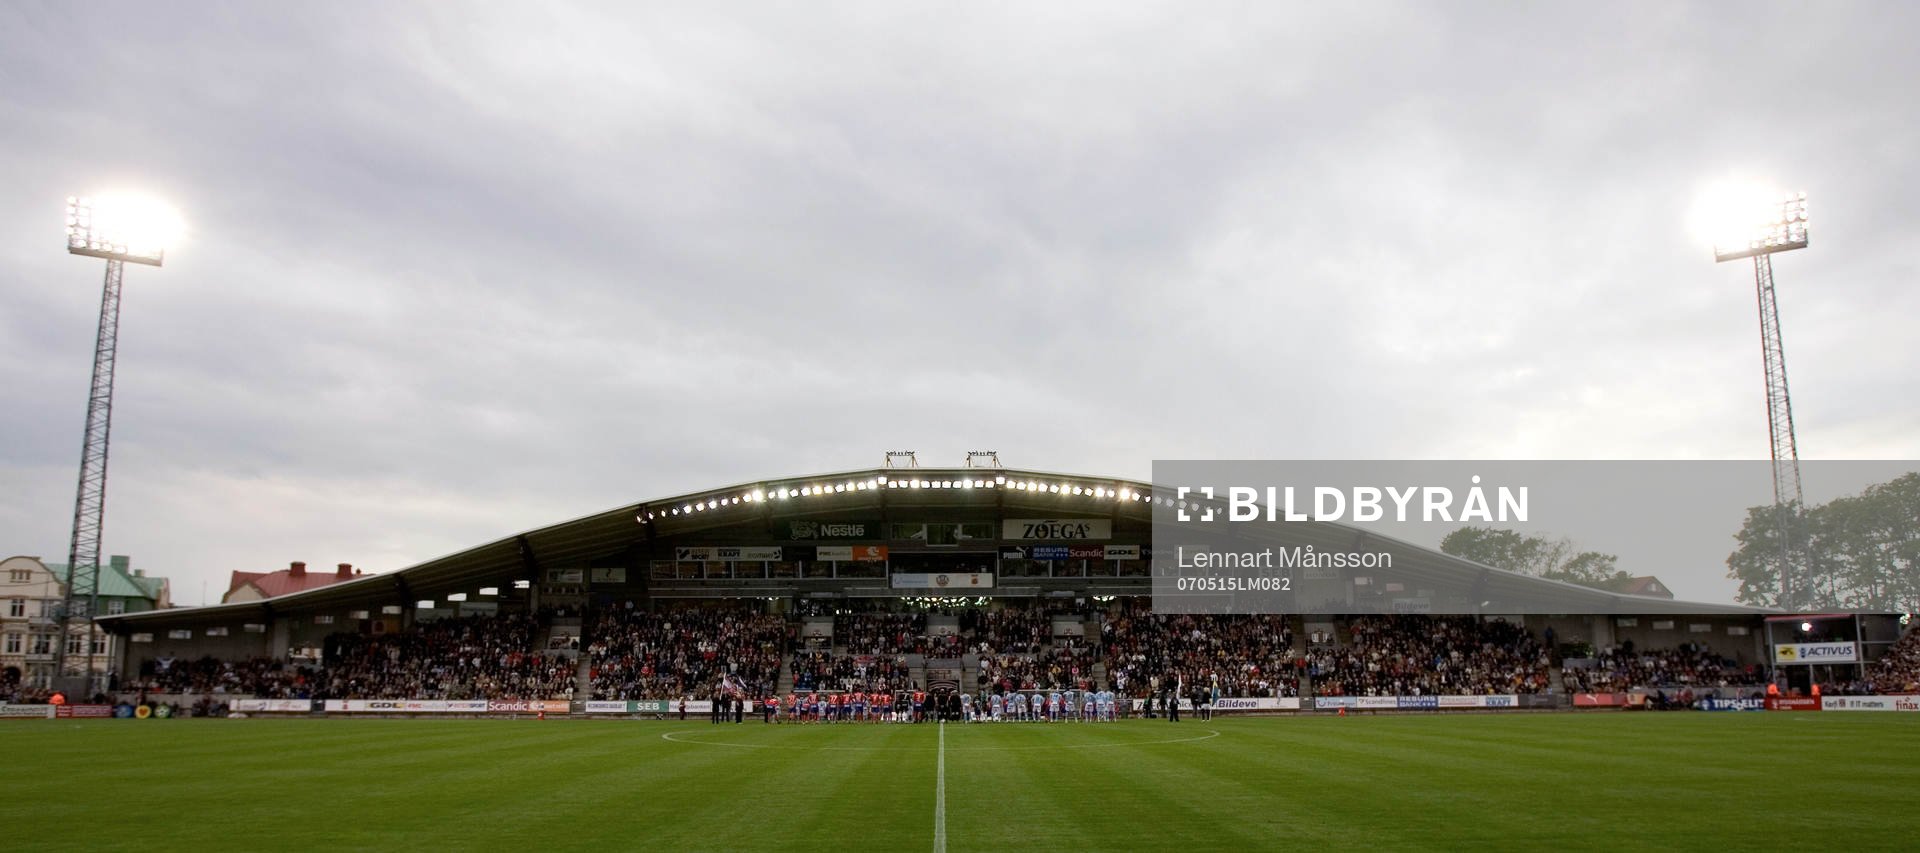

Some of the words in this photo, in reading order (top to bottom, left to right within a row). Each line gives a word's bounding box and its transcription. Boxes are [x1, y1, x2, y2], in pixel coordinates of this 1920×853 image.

[1069, 549, 1103, 558] Scandic
[1808, 646, 1853, 656] ACTIVUS
[489, 701, 528, 711] Scandic
[637, 702, 660, 711] SEB
[1218, 700, 1257, 708] Bildeve
[1896, 700, 1919, 710] finax
